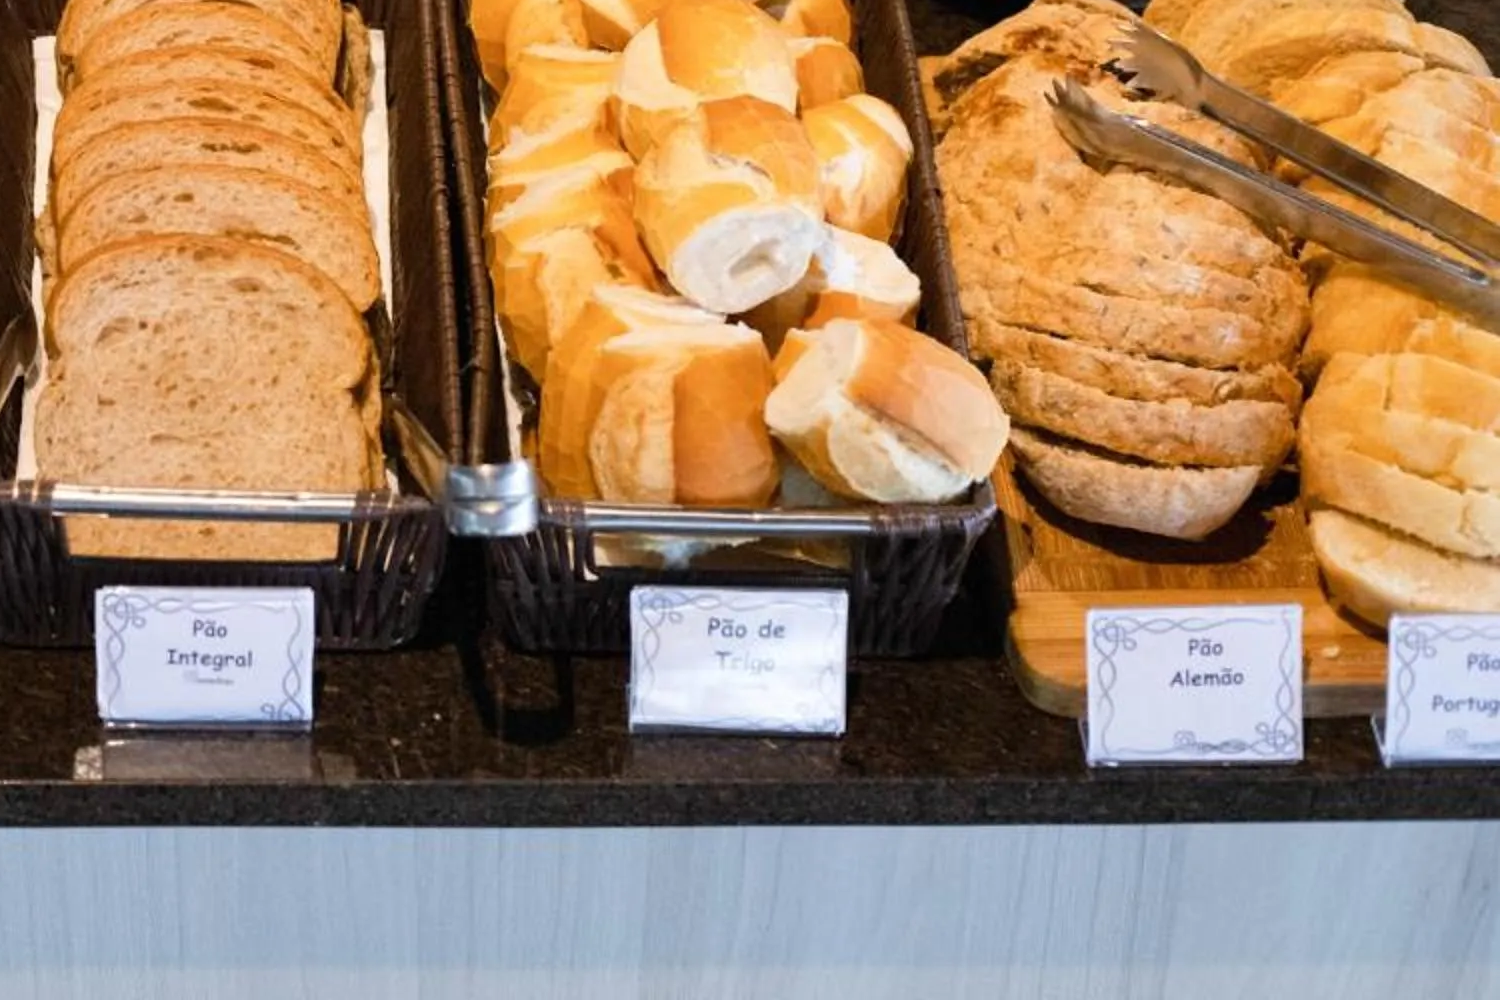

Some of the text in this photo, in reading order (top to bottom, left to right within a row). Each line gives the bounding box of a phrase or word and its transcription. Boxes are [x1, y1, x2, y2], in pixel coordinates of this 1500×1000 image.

[193, 618, 228, 638] Pão
[708, 616, 785, 639] Pão de
[1188, 638, 1224, 657] Pão
[166, 648, 253, 672] Integral
[714, 651, 776, 676] Trigo
[1466, 652, 1500, 672] Pão
[1169, 667, 1245, 688] Alemão
